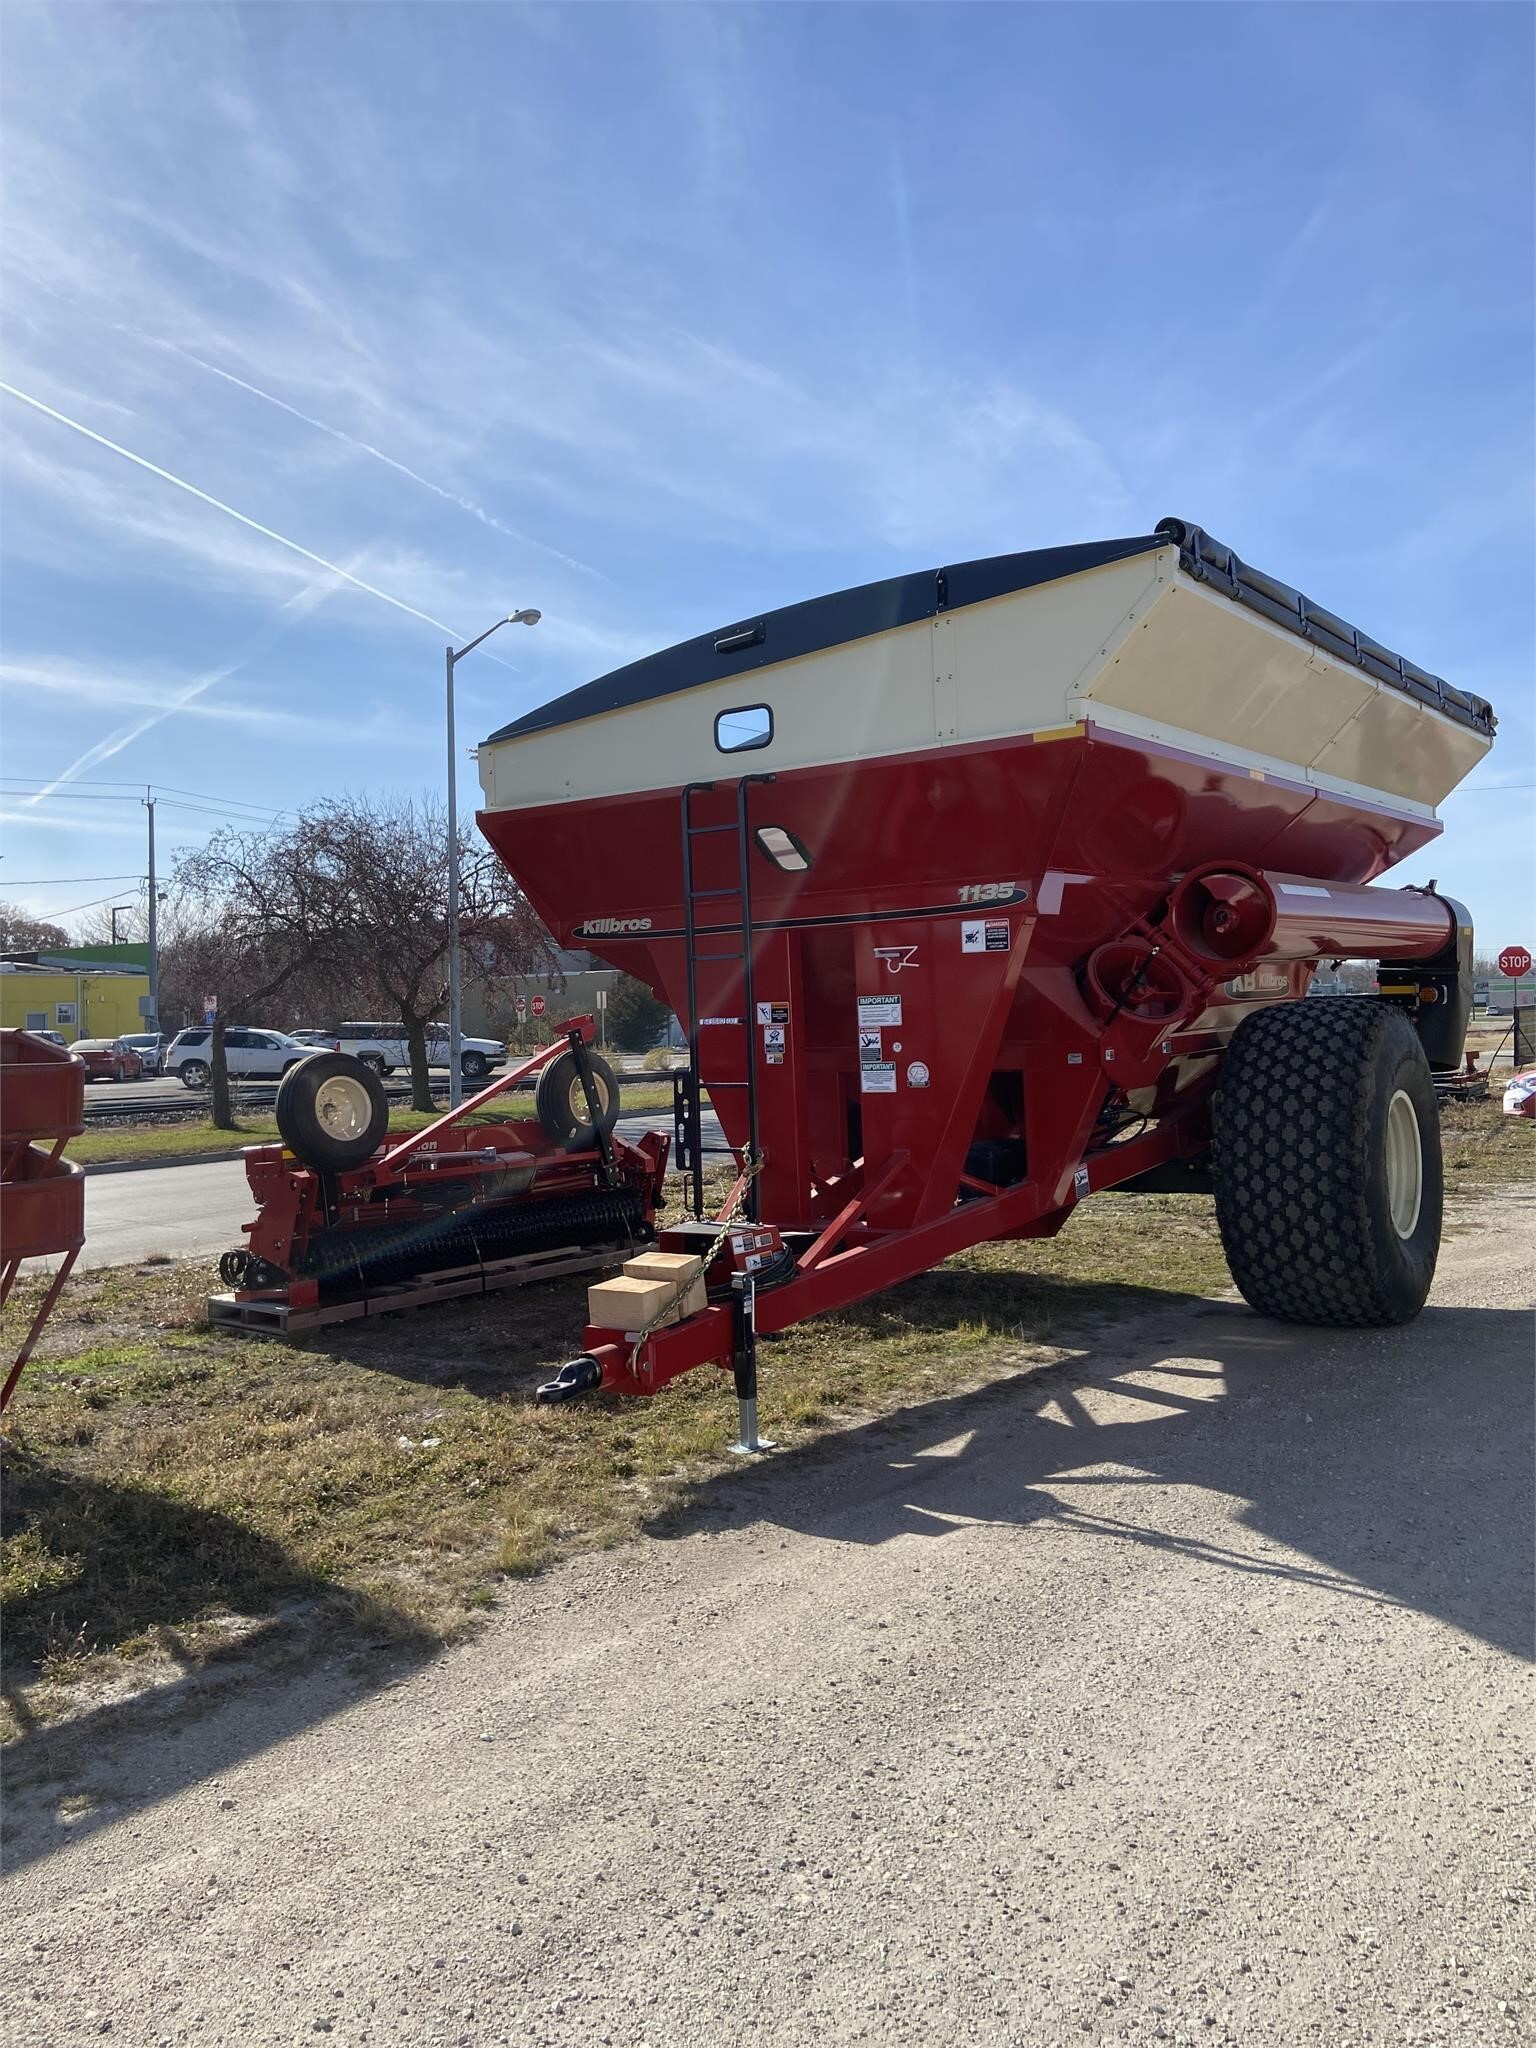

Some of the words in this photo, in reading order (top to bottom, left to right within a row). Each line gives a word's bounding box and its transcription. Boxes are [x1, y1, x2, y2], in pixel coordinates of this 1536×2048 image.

[958, 882, 1015, 902] 1135
[583, 918, 652, 934] Killbros
[1501, 955, 1529, 968] STOP
[532, 1001, 544, 1010] STOP
[859, 996, 898, 1005] IMPORTANT
